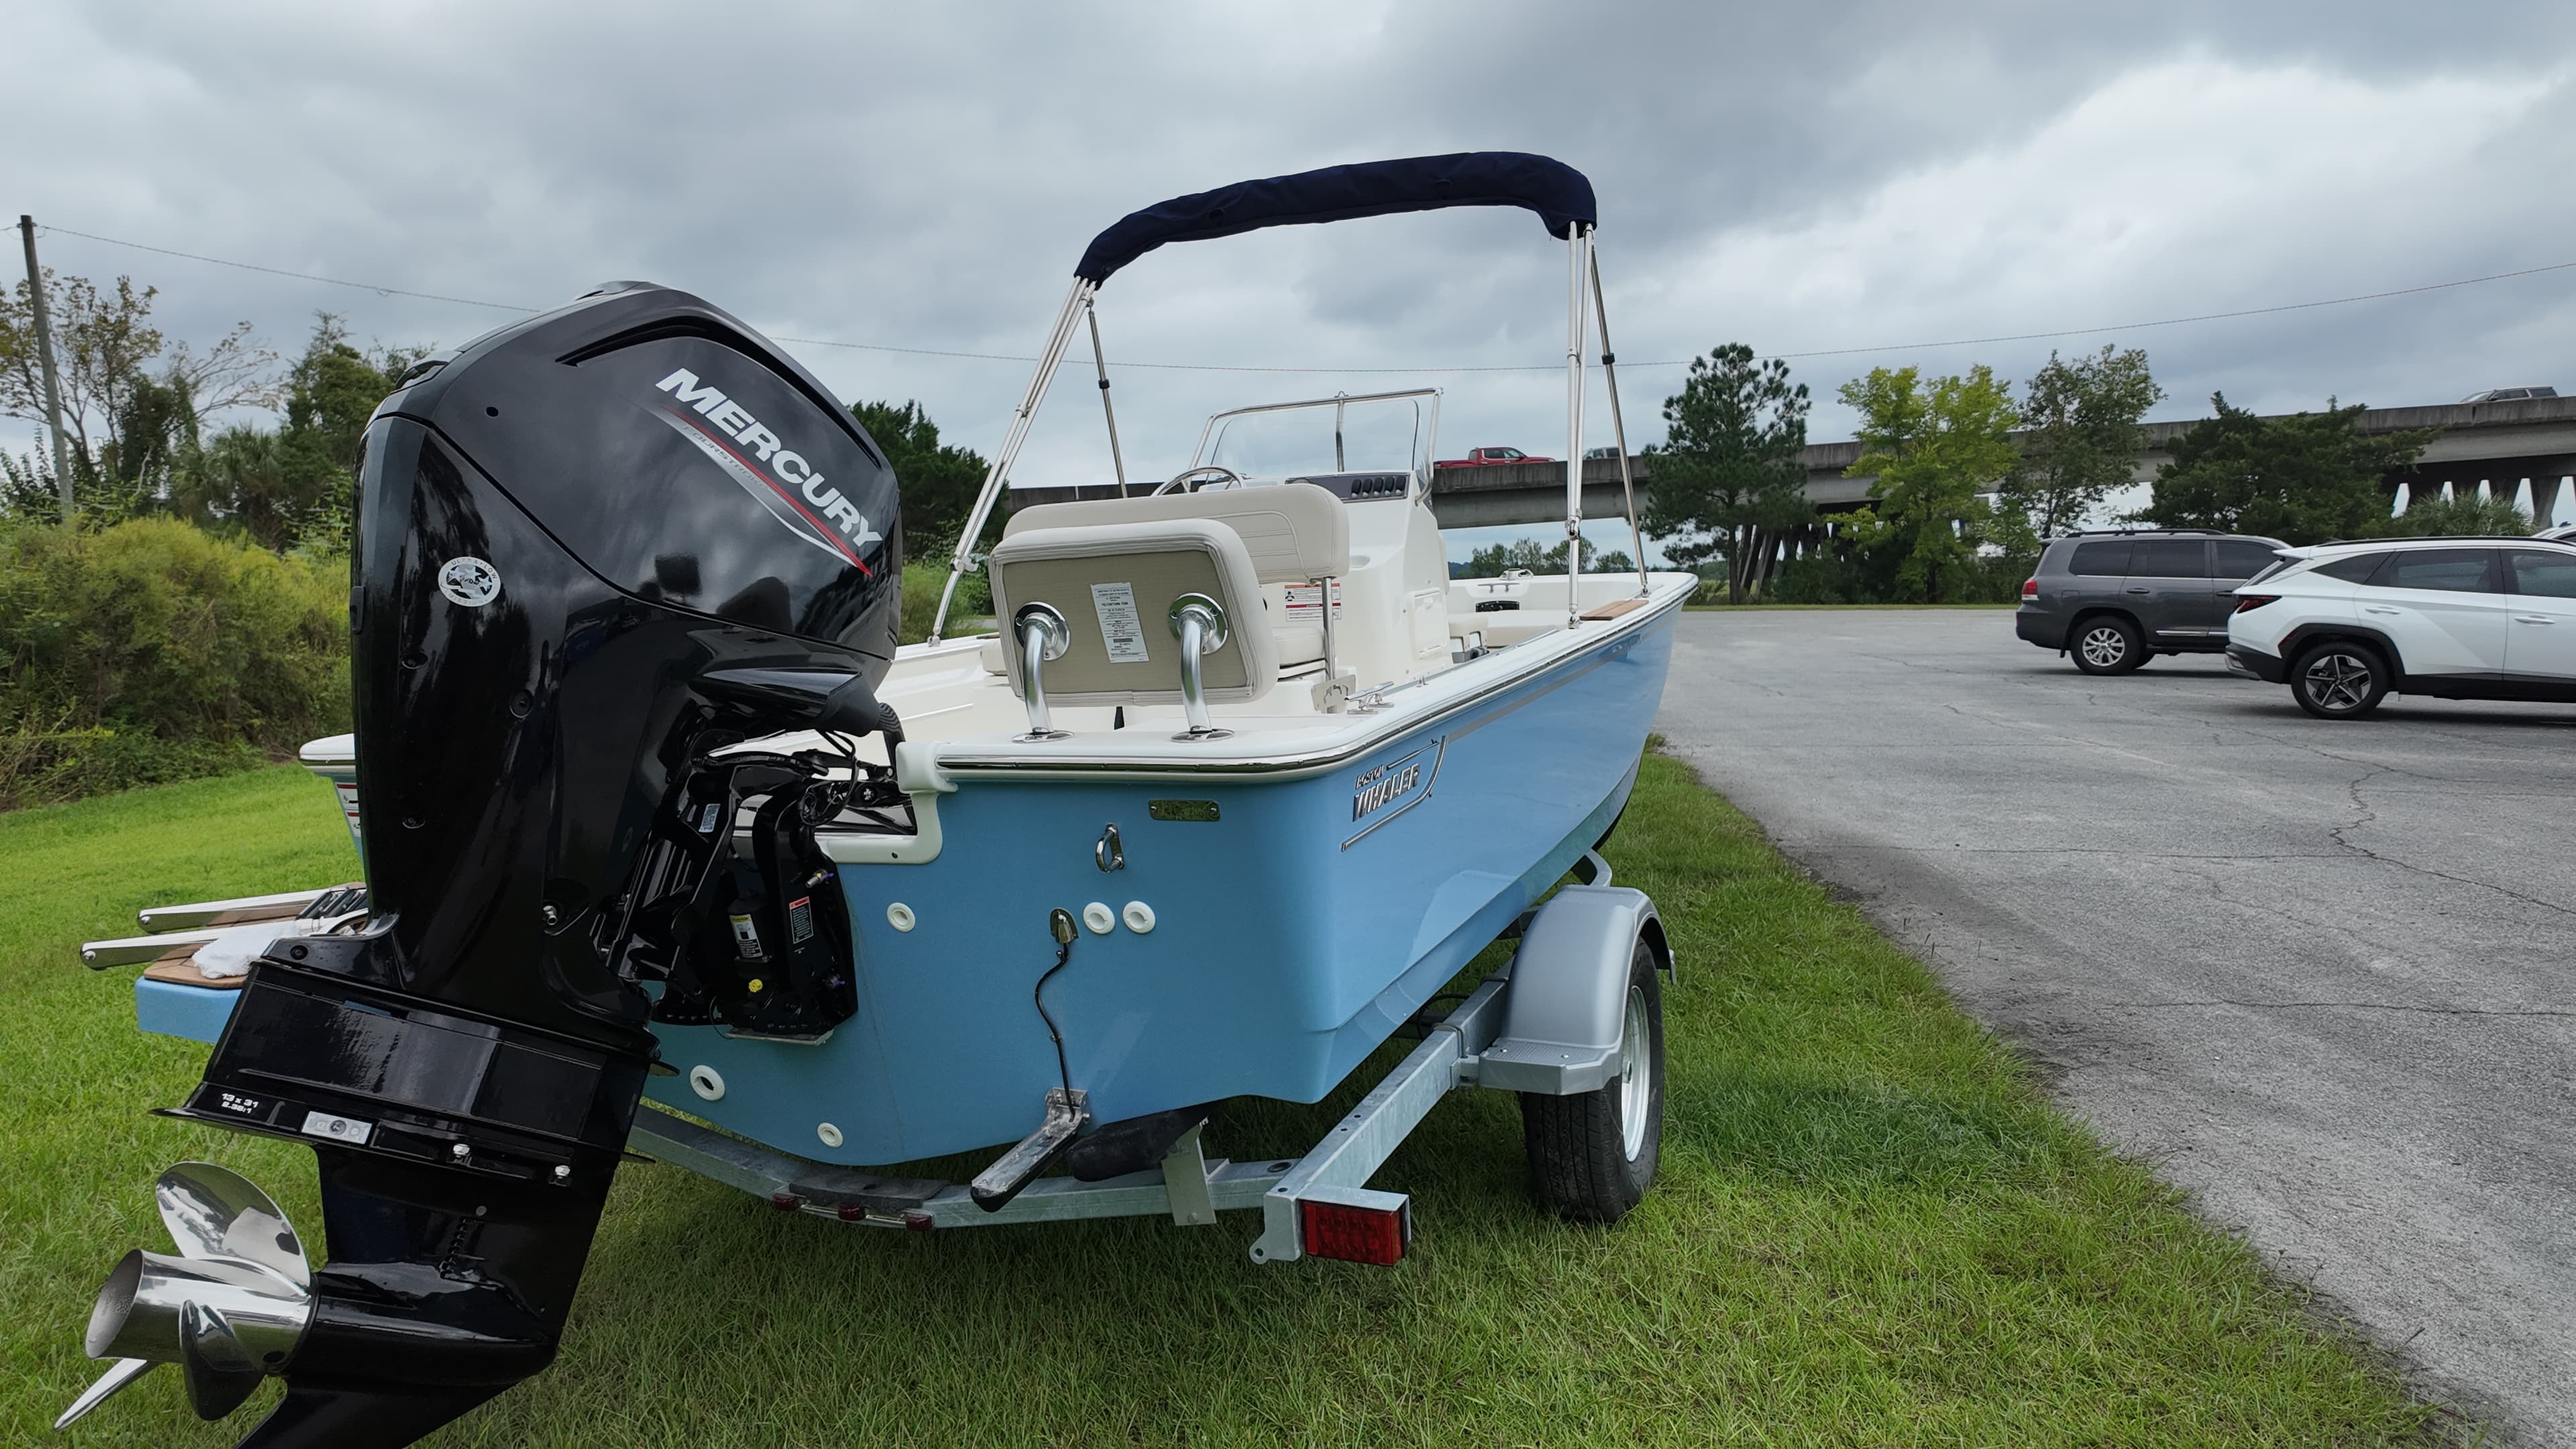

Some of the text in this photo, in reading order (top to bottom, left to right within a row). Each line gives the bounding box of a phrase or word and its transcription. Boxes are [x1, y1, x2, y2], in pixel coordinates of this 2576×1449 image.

[655, 368, 882, 547] MERCURY
[1352, 763, 1420, 822] WHALER
[221, 1093, 235, 1102] 13
[244, 1099, 259, 1108] 31
